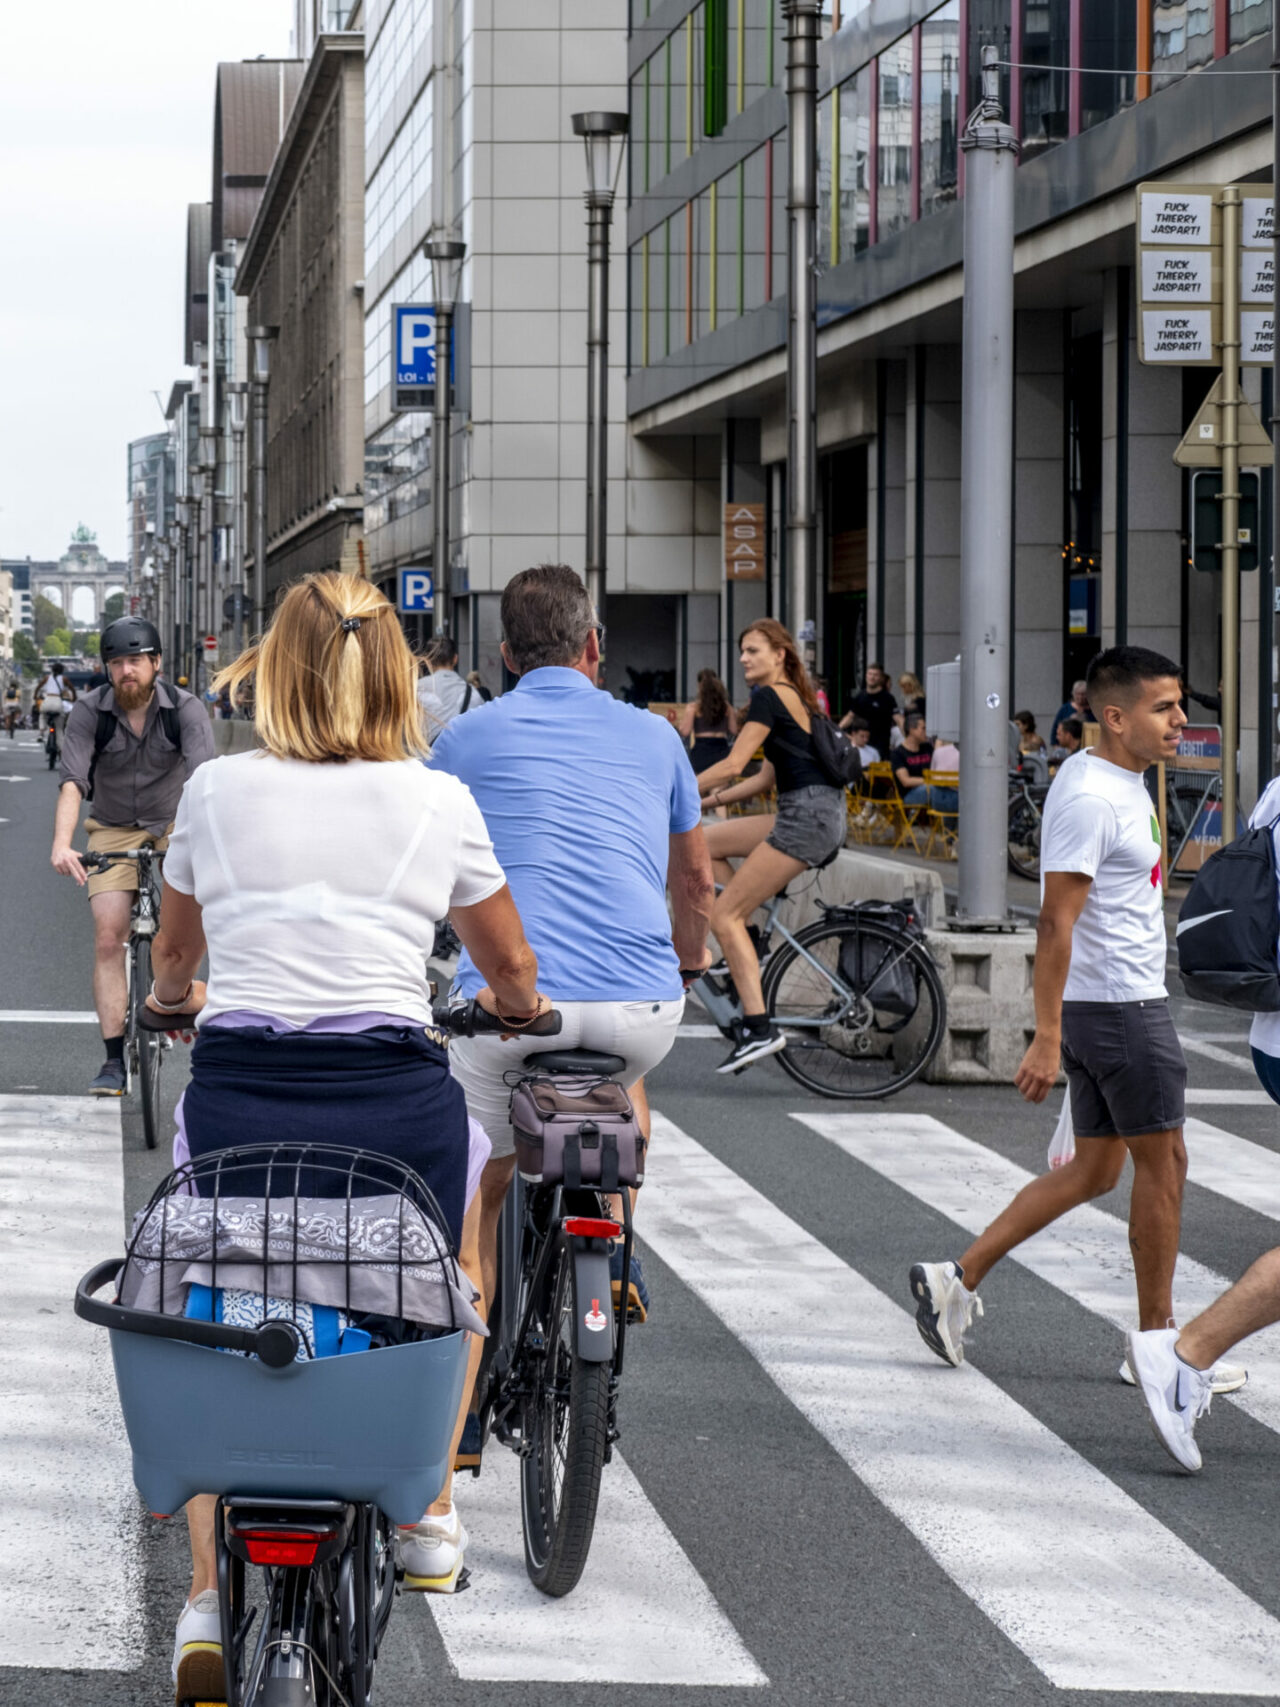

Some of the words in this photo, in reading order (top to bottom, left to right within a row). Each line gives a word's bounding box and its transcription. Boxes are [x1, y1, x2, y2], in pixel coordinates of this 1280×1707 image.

[1164, 202, 1189, 212] FUCK
[1156, 213, 1197, 224] THIERRY
[1151, 225, 1201, 236] JASPART!
[1164, 260, 1189, 270] FUCK
[1156, 271, 1198, 281] THIERRY
[1152, 283, 1201, 292] JASPART!
[1164, 319, 1189, 328] FUCK
[1262, 320, 1275, 330] FU
[401, 314, 437, 366] P
[1157, 330, 1198, 340] THIERRY
[1154, 341, 1202, 351] JASPART!
[399, 372, 417, 383] LOI
[732, 507, 757, 574] ASAP
[406, 575, 431, 606] P
[1194, 834, 1223, 847] VEDE
